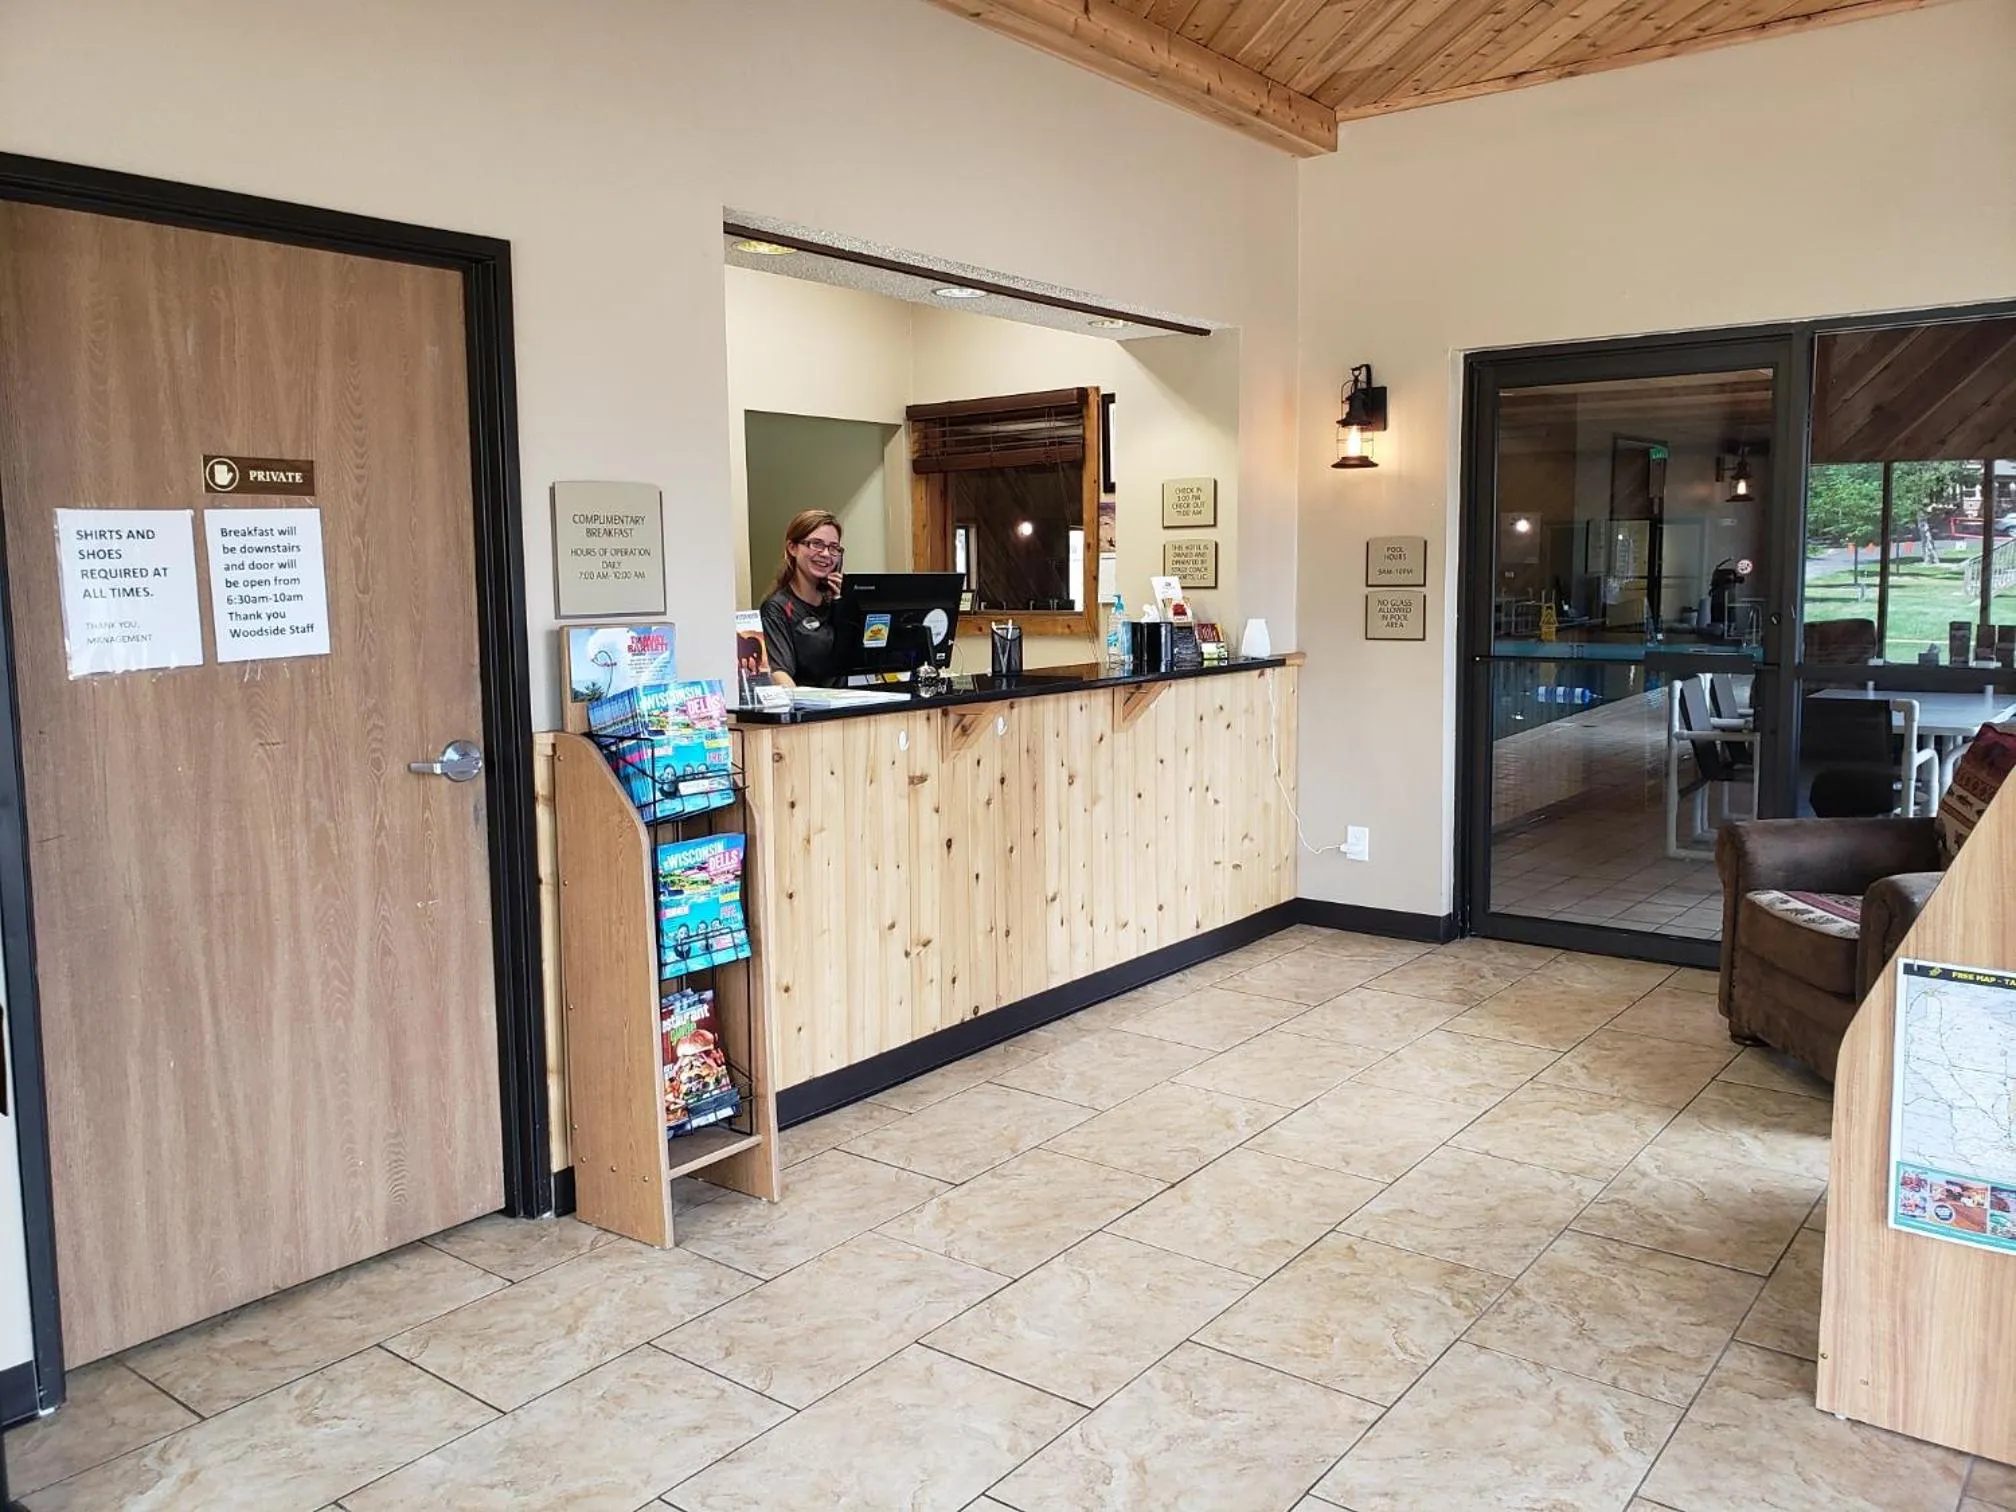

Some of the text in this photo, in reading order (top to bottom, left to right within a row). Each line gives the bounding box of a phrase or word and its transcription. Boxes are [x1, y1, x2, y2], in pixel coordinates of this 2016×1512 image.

[249, 470, 303, 483] PRIVATE
[1175, 487, 1194, 495] CHECK
[1172, 501, 1205, 510] CHECK OUT
[572, 514, 646, 525] COMPLIMENTARY
[76, 529, 156, 541] SHIRTS AND
[220, 526, 297, 537] Breakfast will
[586, 528, 634, 538] BREAKFAST
[222, 543, 302, 554] be downstairs
[571, 548, 651, 557] HOURS OF OPERATION
[78, 549, 123, 560] SHOES
[1384, 553, 1407, 561] HOURS
[224, 559, 297, 571] and door will
[81, 567, 169, 580] REQUIRED AT
[596, 571, 609, 580] AM
[633, 570, 646, 579] AM
[225, 576, 301, 589] be open from
[83, 586, 155, 599] ALL TIMES.
[226, 592, 304, 605] 6:30am-10am
[1377, 599, 1413, 607] NO GLASS
[228, 610, 287, 621] Thank you
[1378, 606, 1412, 614] ALLOWED
[86, 621, 116, 630] THANK
[229, 623, 315, 639] Woodside Staff
[87, 634, 153, 646] MANAGEMENT
[687, 696, 721, 714] DELLS
[666, 841, 724, 868] WISCONSIN
[709, 850, 738, 868] DELLS
[1952, 971, 1975, 981] FREE
[1976, 975, 1996, 983] MAP
